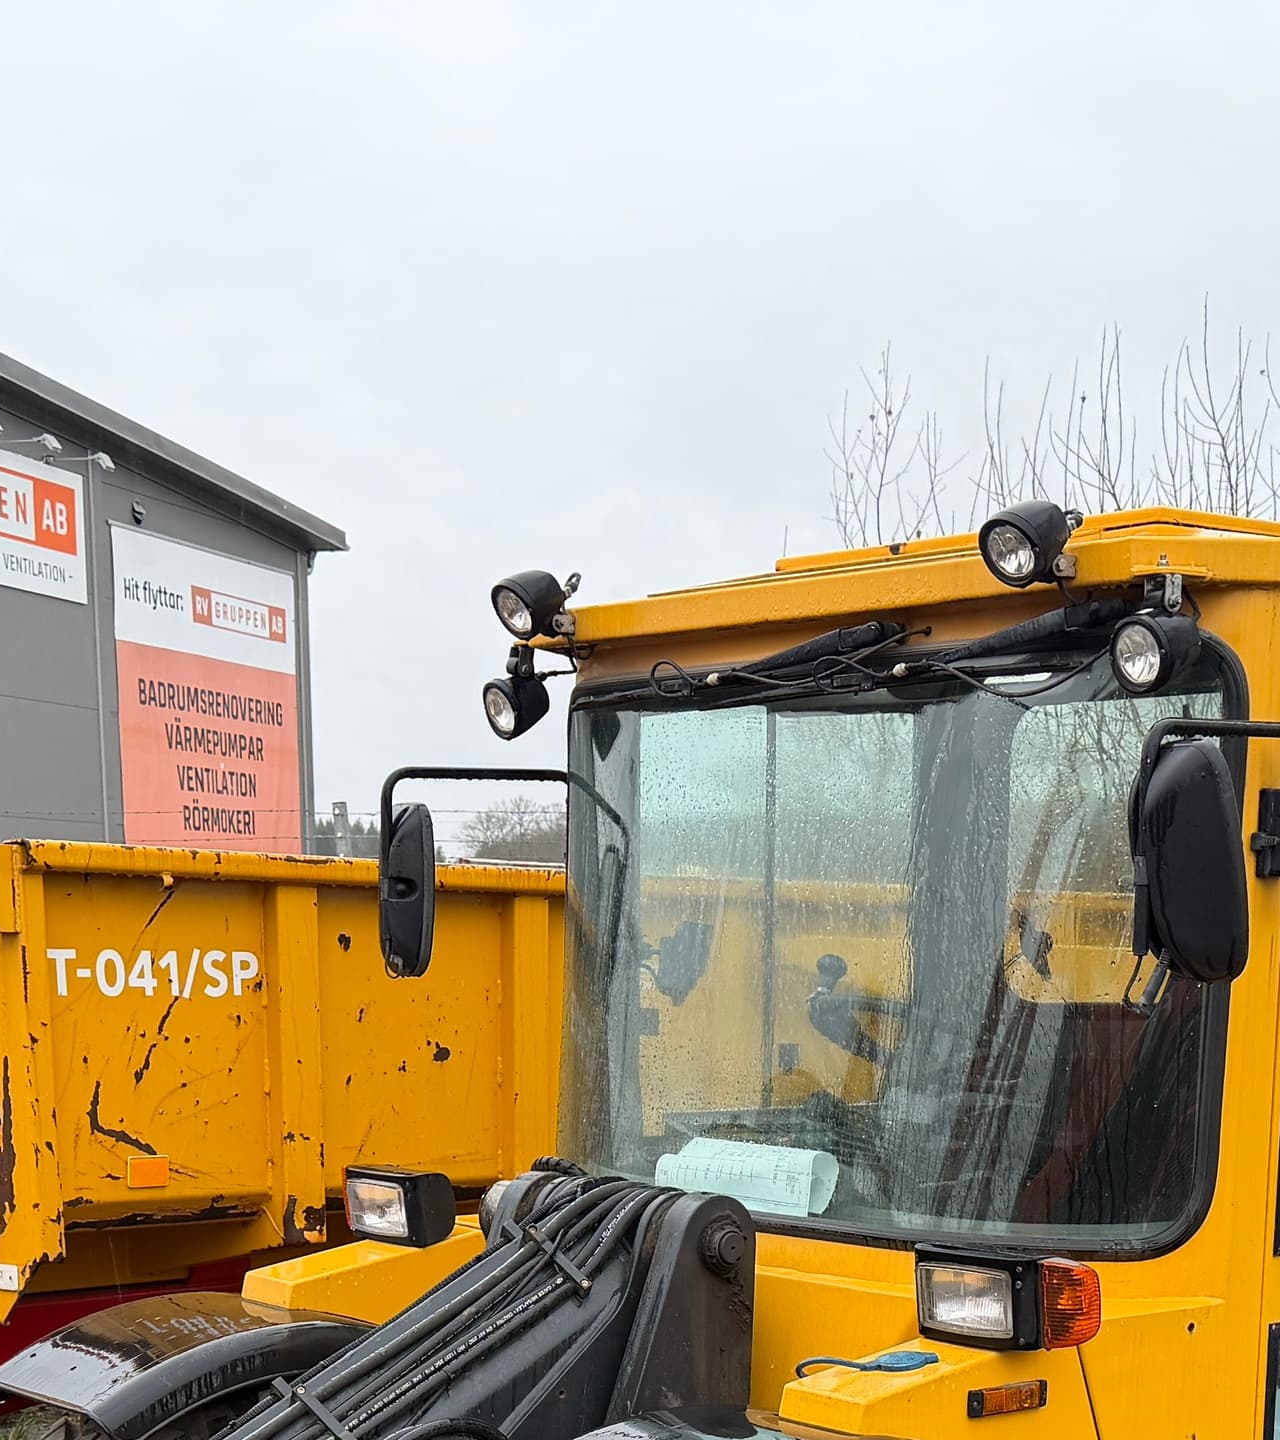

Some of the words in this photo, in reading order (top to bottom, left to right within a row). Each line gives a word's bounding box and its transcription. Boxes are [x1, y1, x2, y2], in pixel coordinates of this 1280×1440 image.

[42, 499, 68, 536] AB
[3, 553, 66, 583] VENTILATION
[123, 577, 140, 600] Hit
[142, 581, 184, 611] flyttar:
[195, 595, 209, 616] RV
[214, 601, 267, 631] GRUPPEN
[271, 615, 284, 634] AB
[138, 678, 283, 726] BADRUMSRENOVERING
[165, 717, 264, 762] VÄRMEPUMPAR
[177, 765, 257, 798] VENTILATION
[183, 800, 256, 835] RÖRMOKERI
[46, 948, 259, 999] T-041/SP
